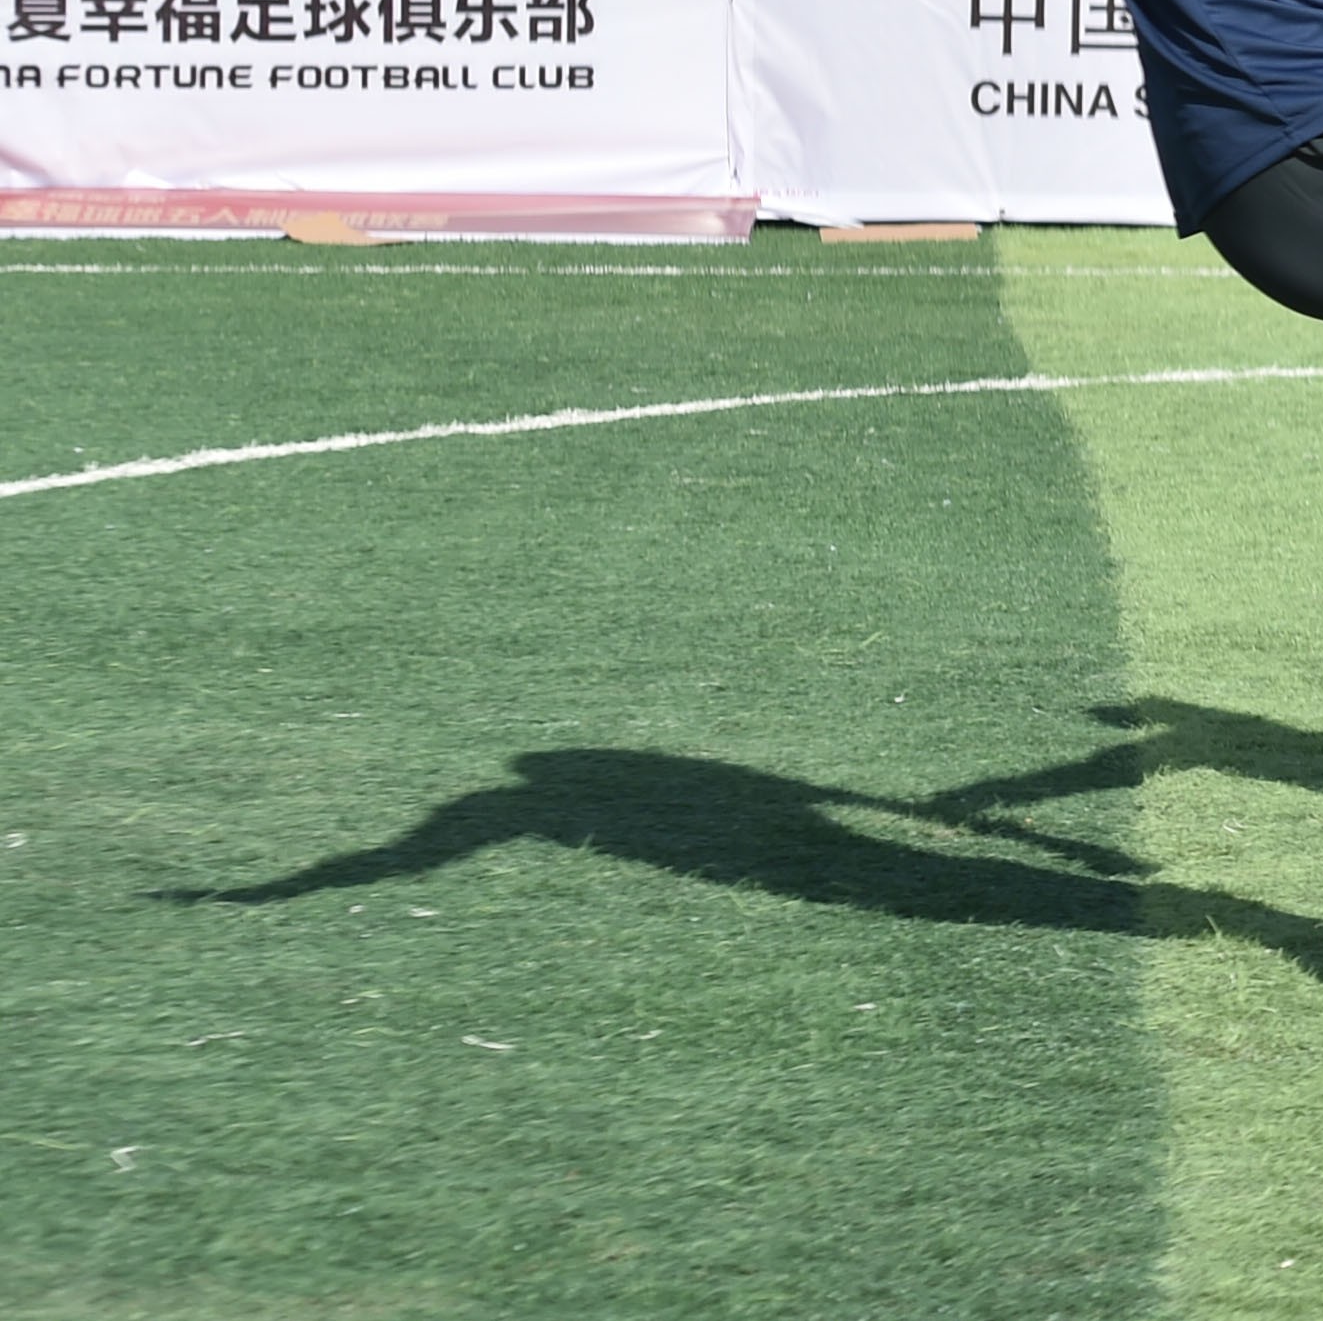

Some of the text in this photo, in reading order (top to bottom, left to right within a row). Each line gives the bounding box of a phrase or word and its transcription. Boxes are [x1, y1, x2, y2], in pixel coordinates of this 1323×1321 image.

[57, 65, 253, 89] FORTUNE
[269, 65, 478, 89] FOOTBALL
[492, 65, 595, 89] CLUB
[971, 81, 1119, 117] CHINA
